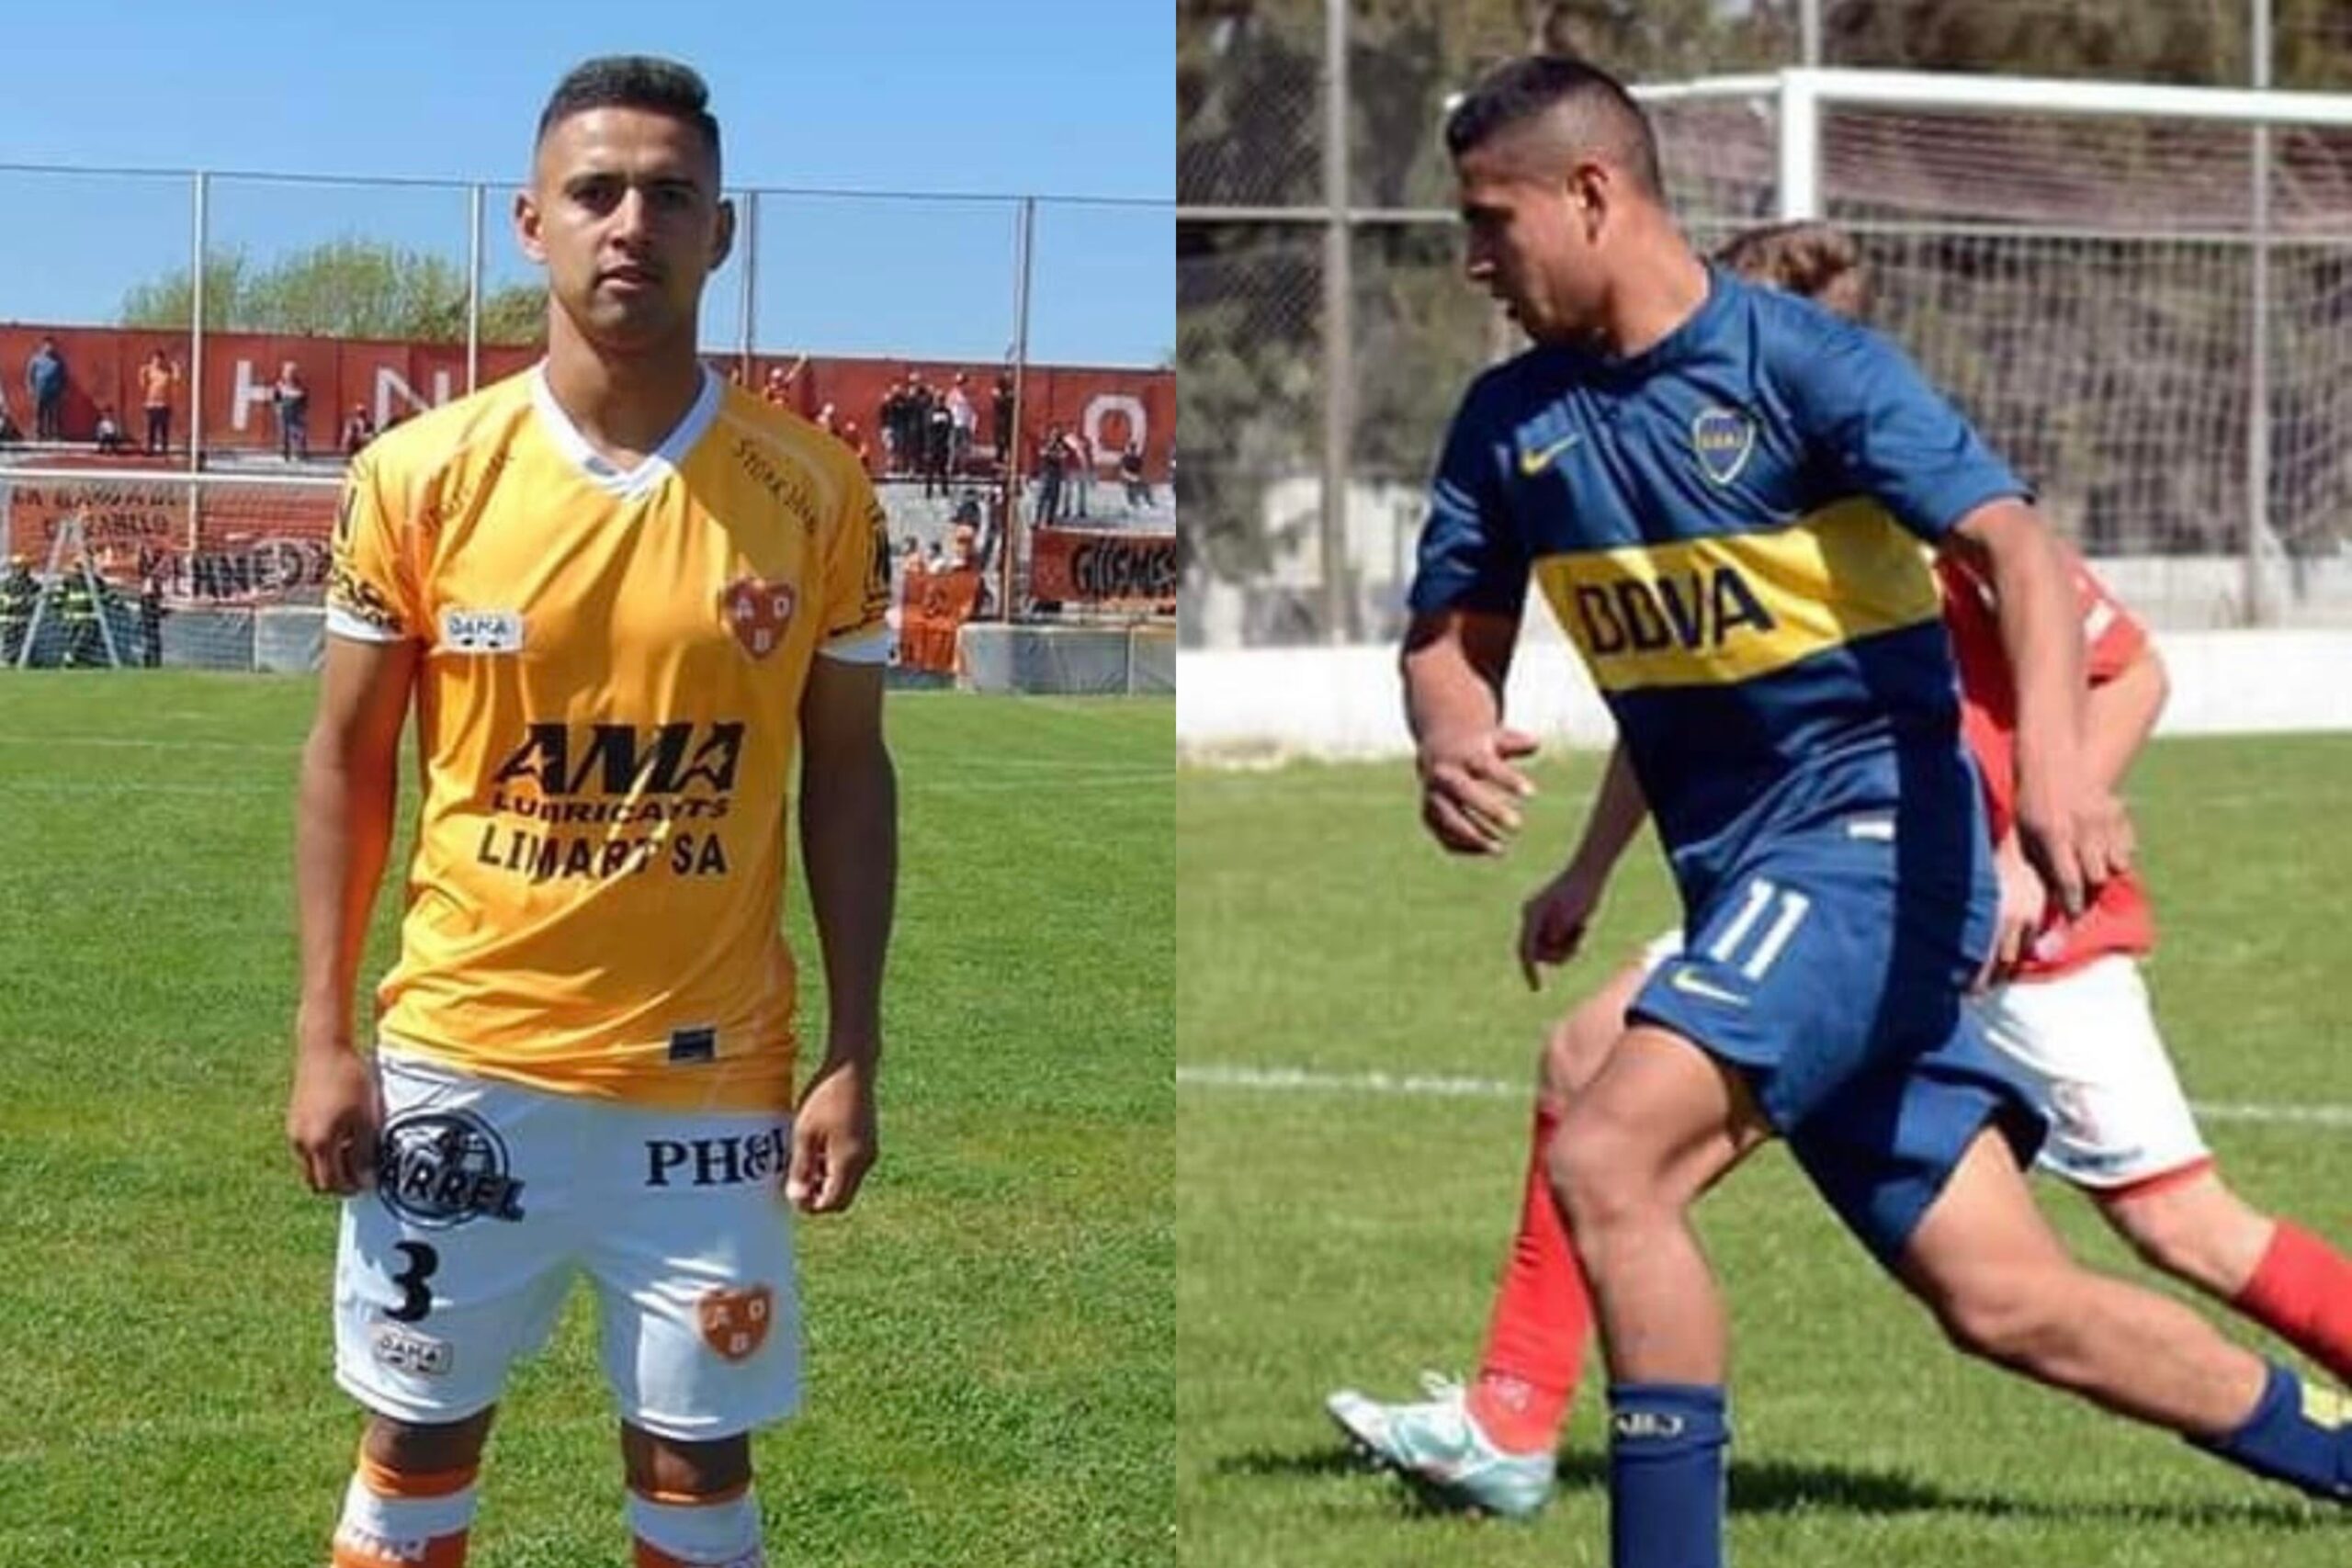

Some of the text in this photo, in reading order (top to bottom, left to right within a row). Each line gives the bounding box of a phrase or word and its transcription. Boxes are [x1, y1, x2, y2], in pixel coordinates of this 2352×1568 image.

[493, 723, 744, 794] AMA
[672, 833, 727, 875] SA
[1710, 879, 1810, 979] 11
[383, 1241, 438, 1321] 3
